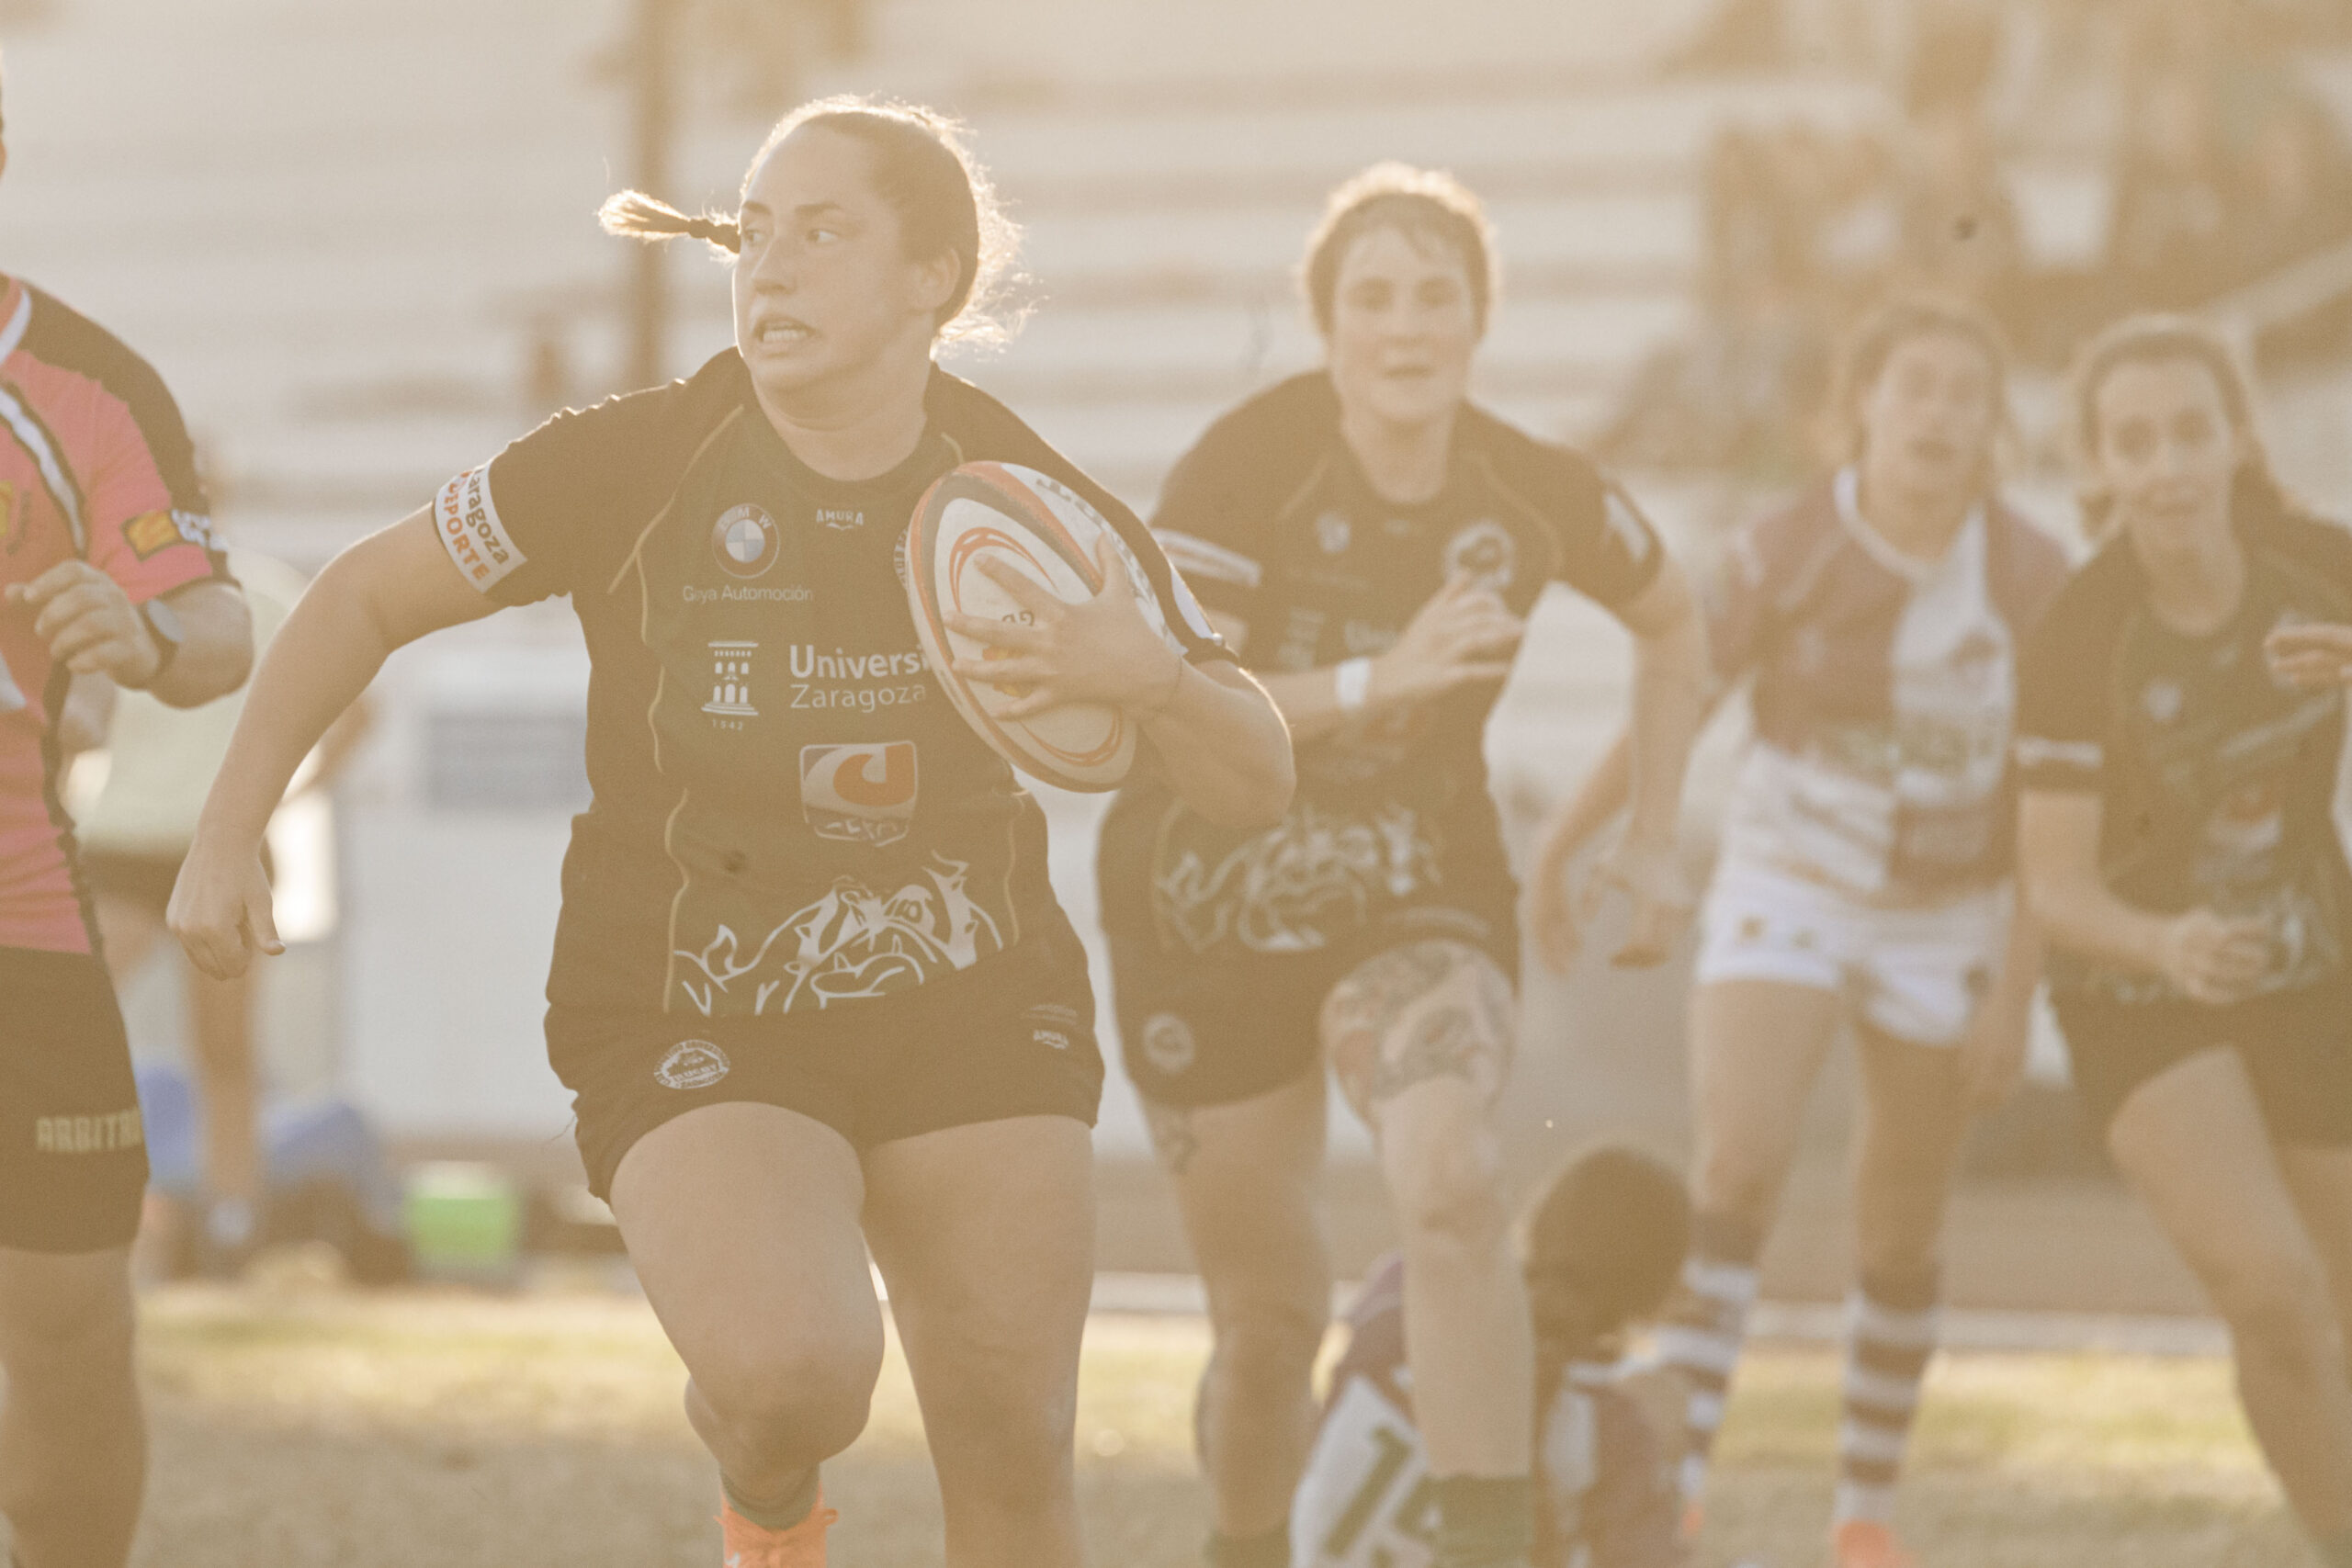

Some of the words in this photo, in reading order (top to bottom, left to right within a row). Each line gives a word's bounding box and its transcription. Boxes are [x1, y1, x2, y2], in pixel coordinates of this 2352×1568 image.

[466, 469, 509, 564] aragoza
[817, 509, 864, 525] AMURA
[721, 585, 813, 602] Automoción
[790, 684, 925, 713] Zaragoza
[713, 720, 743, 731] 1542
